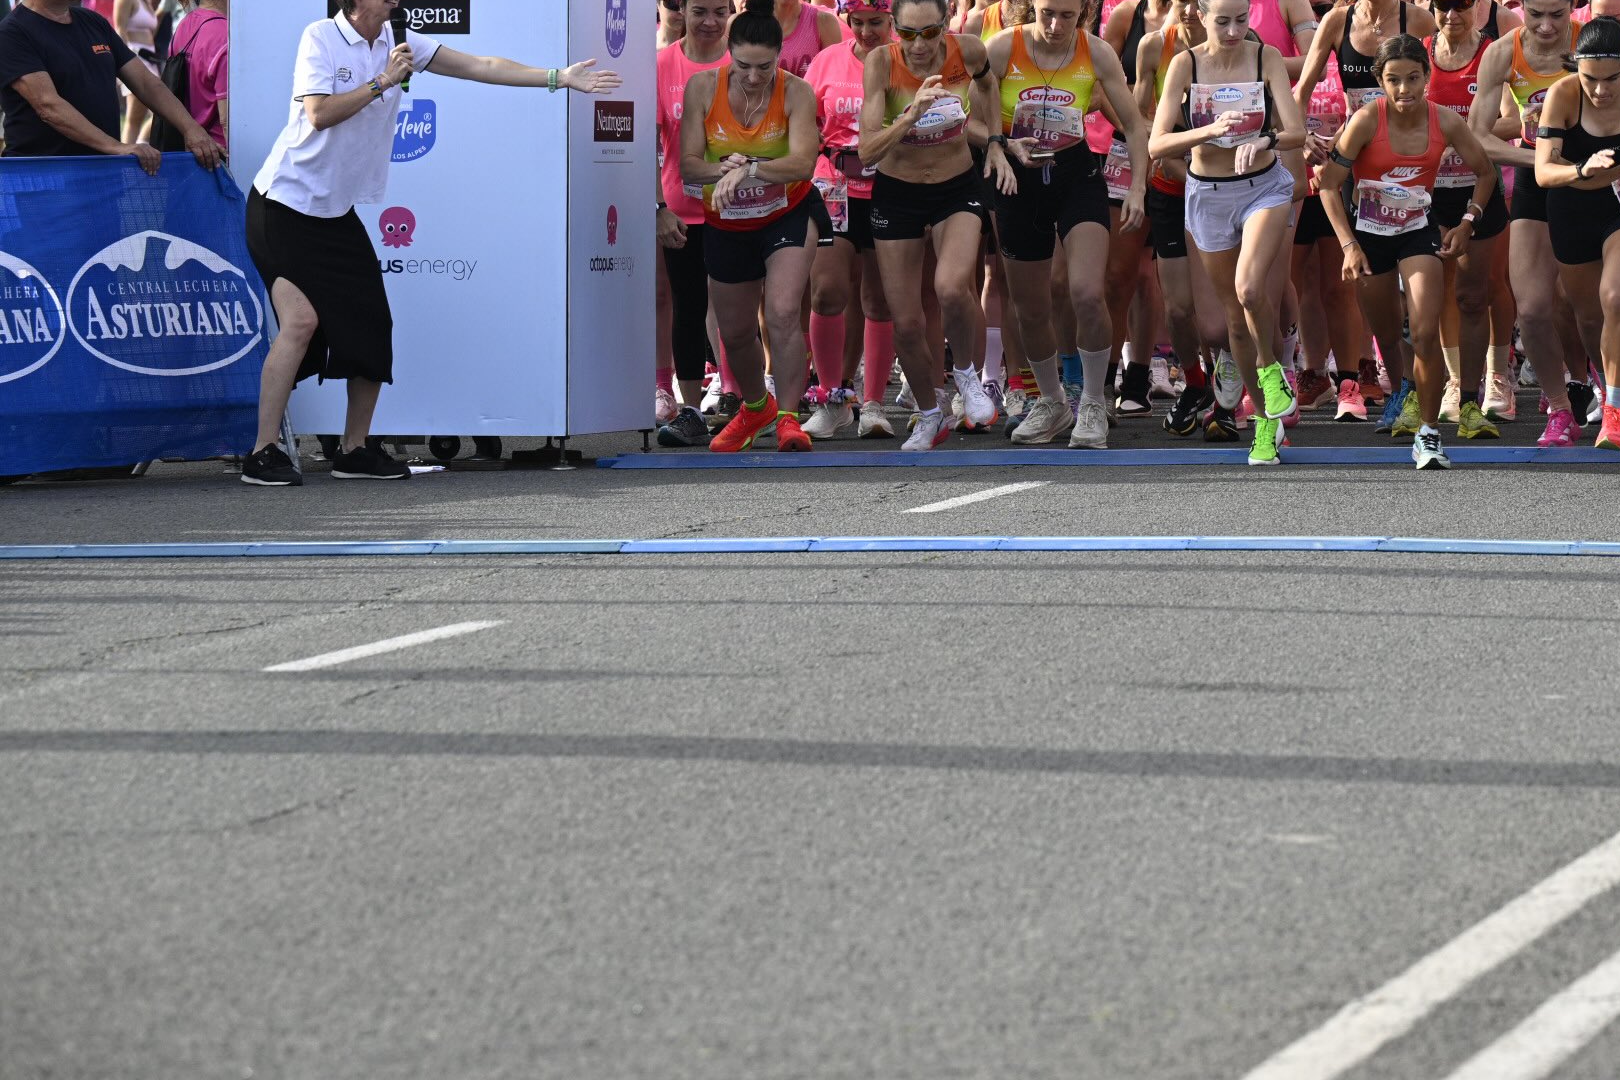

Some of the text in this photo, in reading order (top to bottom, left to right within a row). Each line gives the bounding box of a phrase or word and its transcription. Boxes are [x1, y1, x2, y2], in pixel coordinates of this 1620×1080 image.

[1022, 90, 1072, 103] Serrano
[597, 109, 632, 137] Neutrogena
[1033, 129, 1060, 141] 016
[407, 145, 427, 158] ALPES
[1390, 166, 1422, 177] NIKE
[738, 186, 765, 198] 016
[1380, 205, 1407, 219] 016
[406, 259, 478, 281] energy
[590, 255, 613, 276] octopus
[108, 279, 238, 296] CENTRAL LECHERA
[86, 286, 253, 340] ASTURIANA
